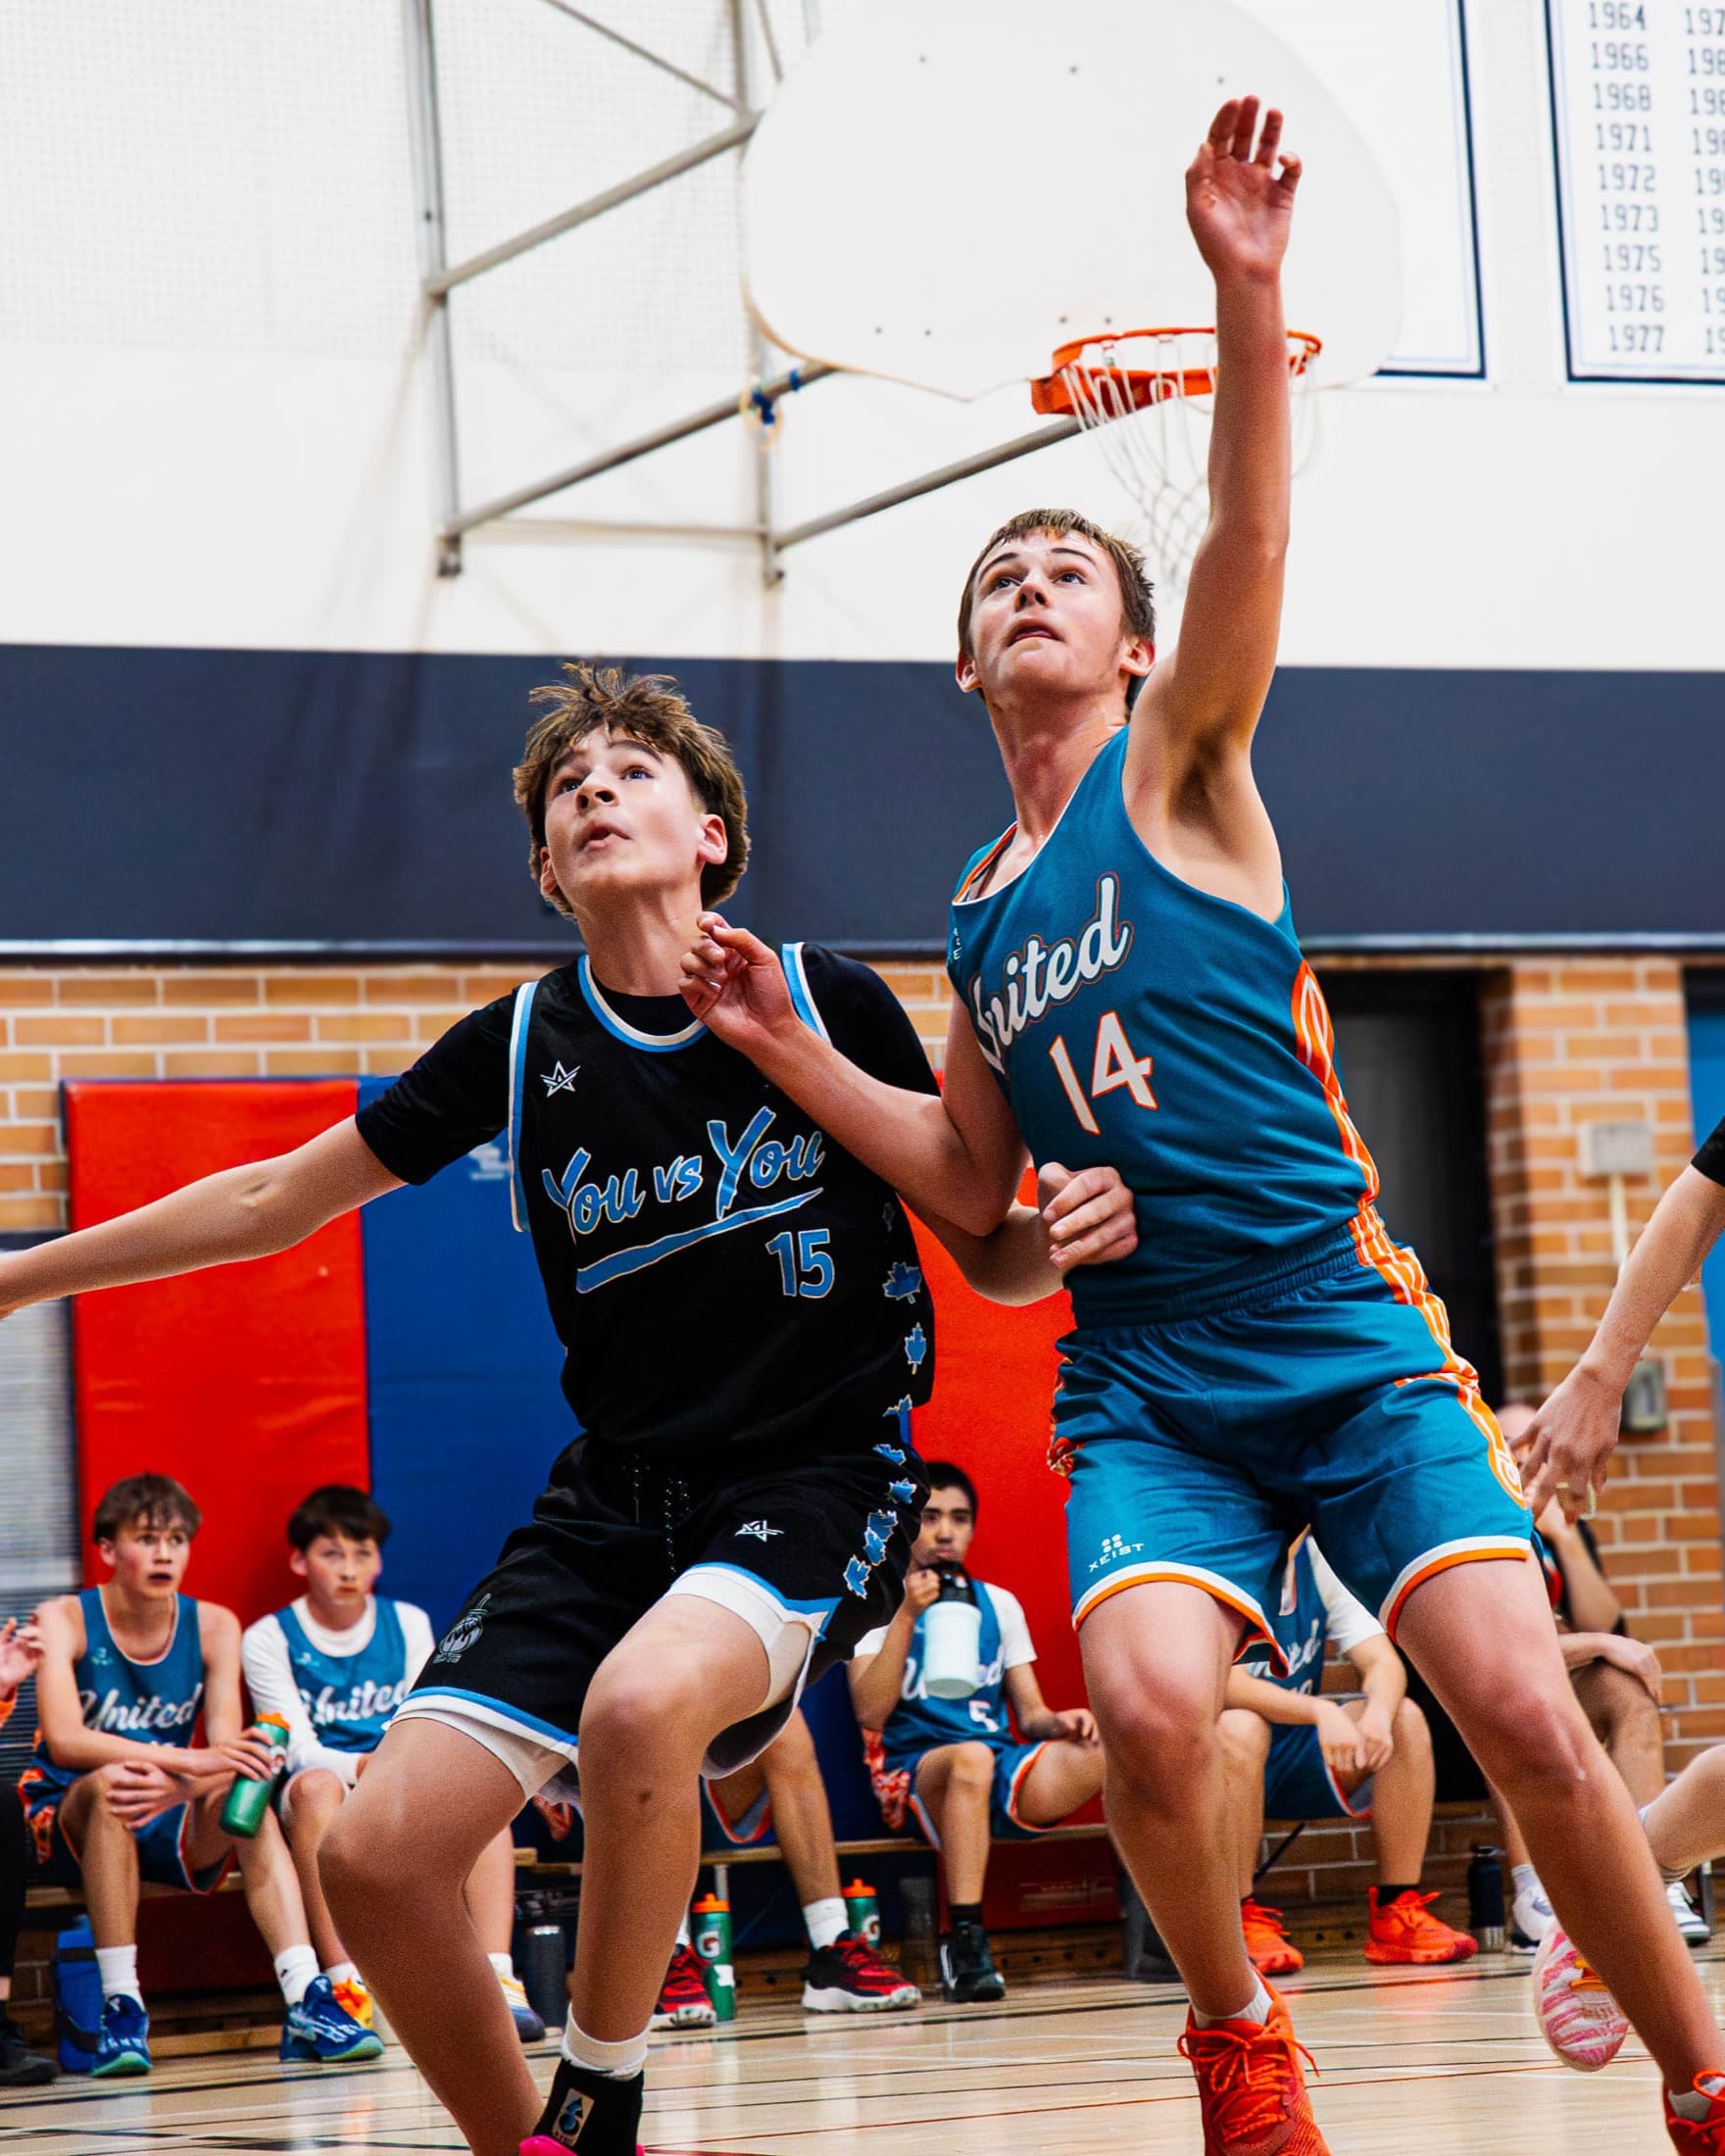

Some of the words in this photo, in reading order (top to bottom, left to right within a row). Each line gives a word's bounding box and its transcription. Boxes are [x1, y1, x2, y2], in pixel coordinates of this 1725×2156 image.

[1590, 2, 1647, 31] 1964
[1592, 42, 1649, 71] 1966
[1594, 83, 1651, 112] 1968
[1597, 123, 1651, 152] 1971
[1600, 164, 1654, 192] 1972
[1602, 204, 1657, 232] 1973
[1604, 245, 1660, 271] 1975
[1607, 285, 1663, 312] 1976
[1609, 324, 1664, 353] 1977
[1049, 1010, 1158, 1137] 14
[542, 1148, 646, 1245] You
[654, 1155, 703, 1202] vs
[707, 1105, 826, 1220] You
[766, 1229, 835, 1298] 15
[1088, 1543, 1145, 1573] XEIST
[79, 1683, 203, 1731] United
[697, 1931, 720, 1959] G
